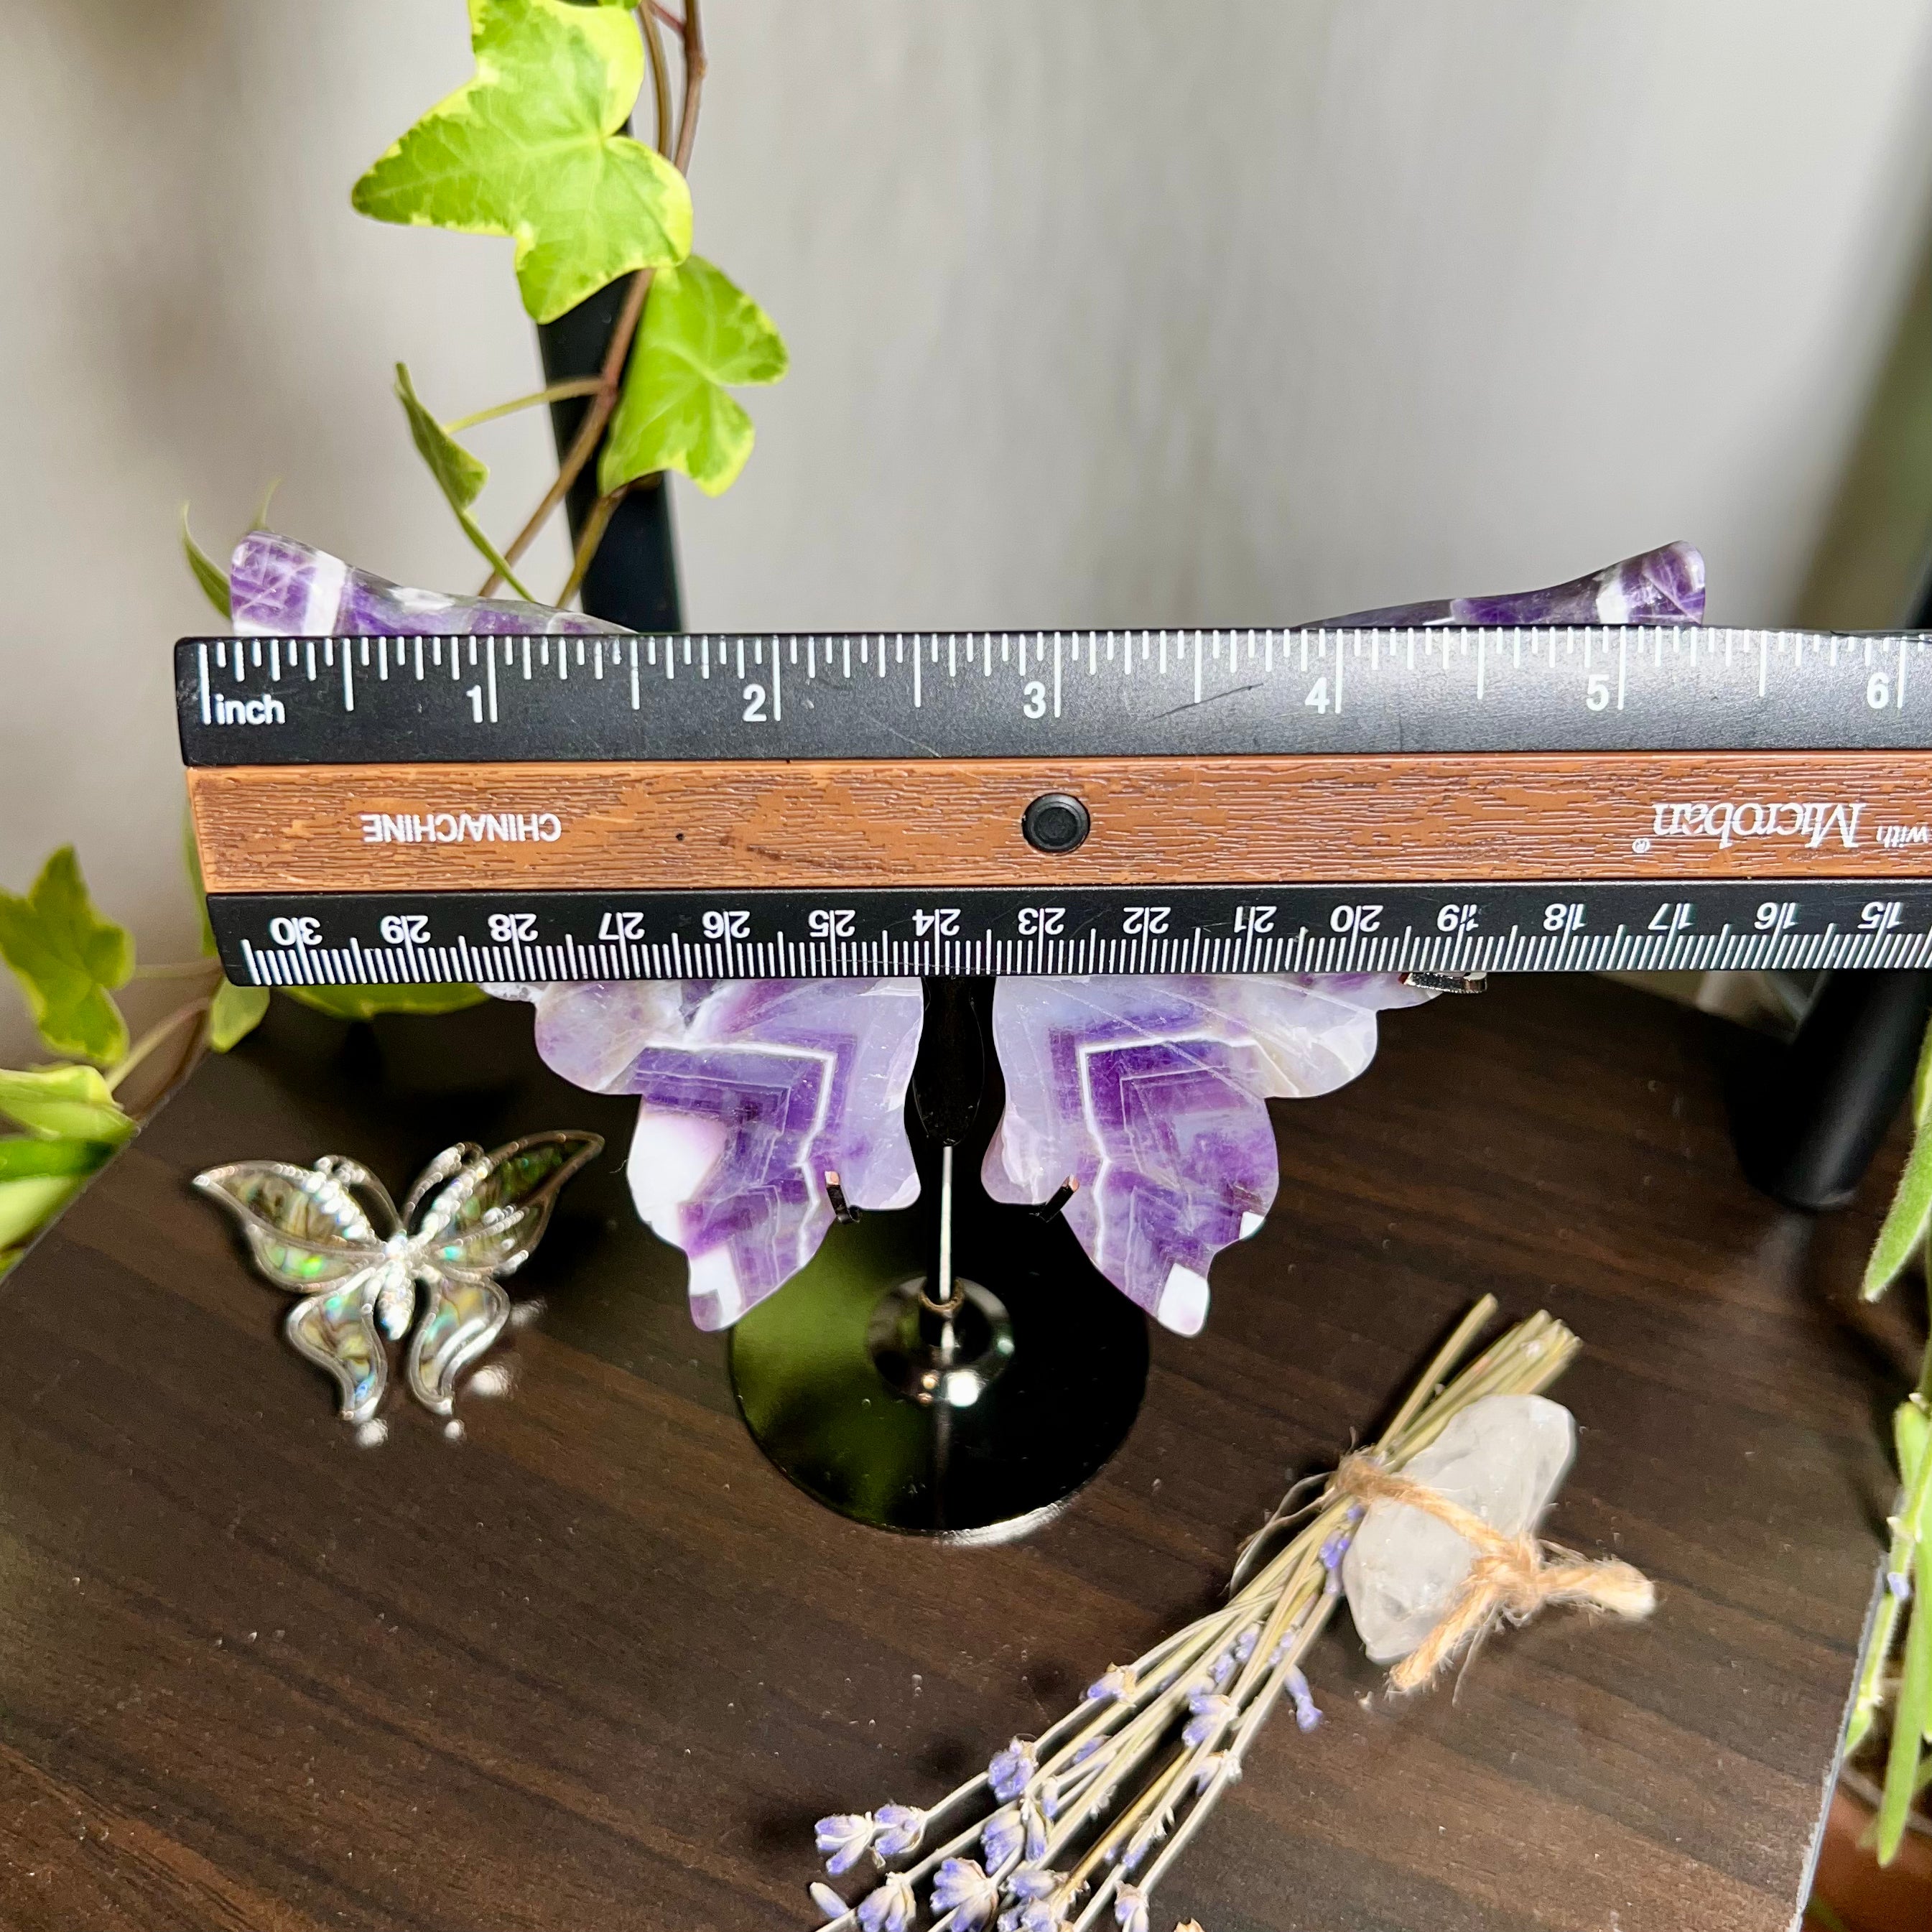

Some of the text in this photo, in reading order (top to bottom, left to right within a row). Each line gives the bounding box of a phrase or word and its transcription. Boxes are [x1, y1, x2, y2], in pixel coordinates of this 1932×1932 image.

[215, 672, 1889, 725] inch 1 2 3 4 5 6
[360, 812, 562, 842] CHINA/CHINE
[1877, 825, 1929, 848] with
[488, 913, 538, 942] 28
[598, 911, 645, 941] 27
[702, 910, 751, 939] 26
[809, 909, 855, 937] 25
[912, 909, 960, 936] 24
[1018, 908, 1065, 935] 23
[1123, 906, 1171, 934] 22
[1235, 905, 1277, 932] 21
[1330, 904, 1383, 932] 20
[1544, 903, 1587, 931] 18
[1648, 902, 1695, 930] 17
[1755, 902, 1799, 930] 16
[1857, 901, 1903, 929] 15
[269, 916, 323, 946] 30
[380, 915, 431, 944] 29
